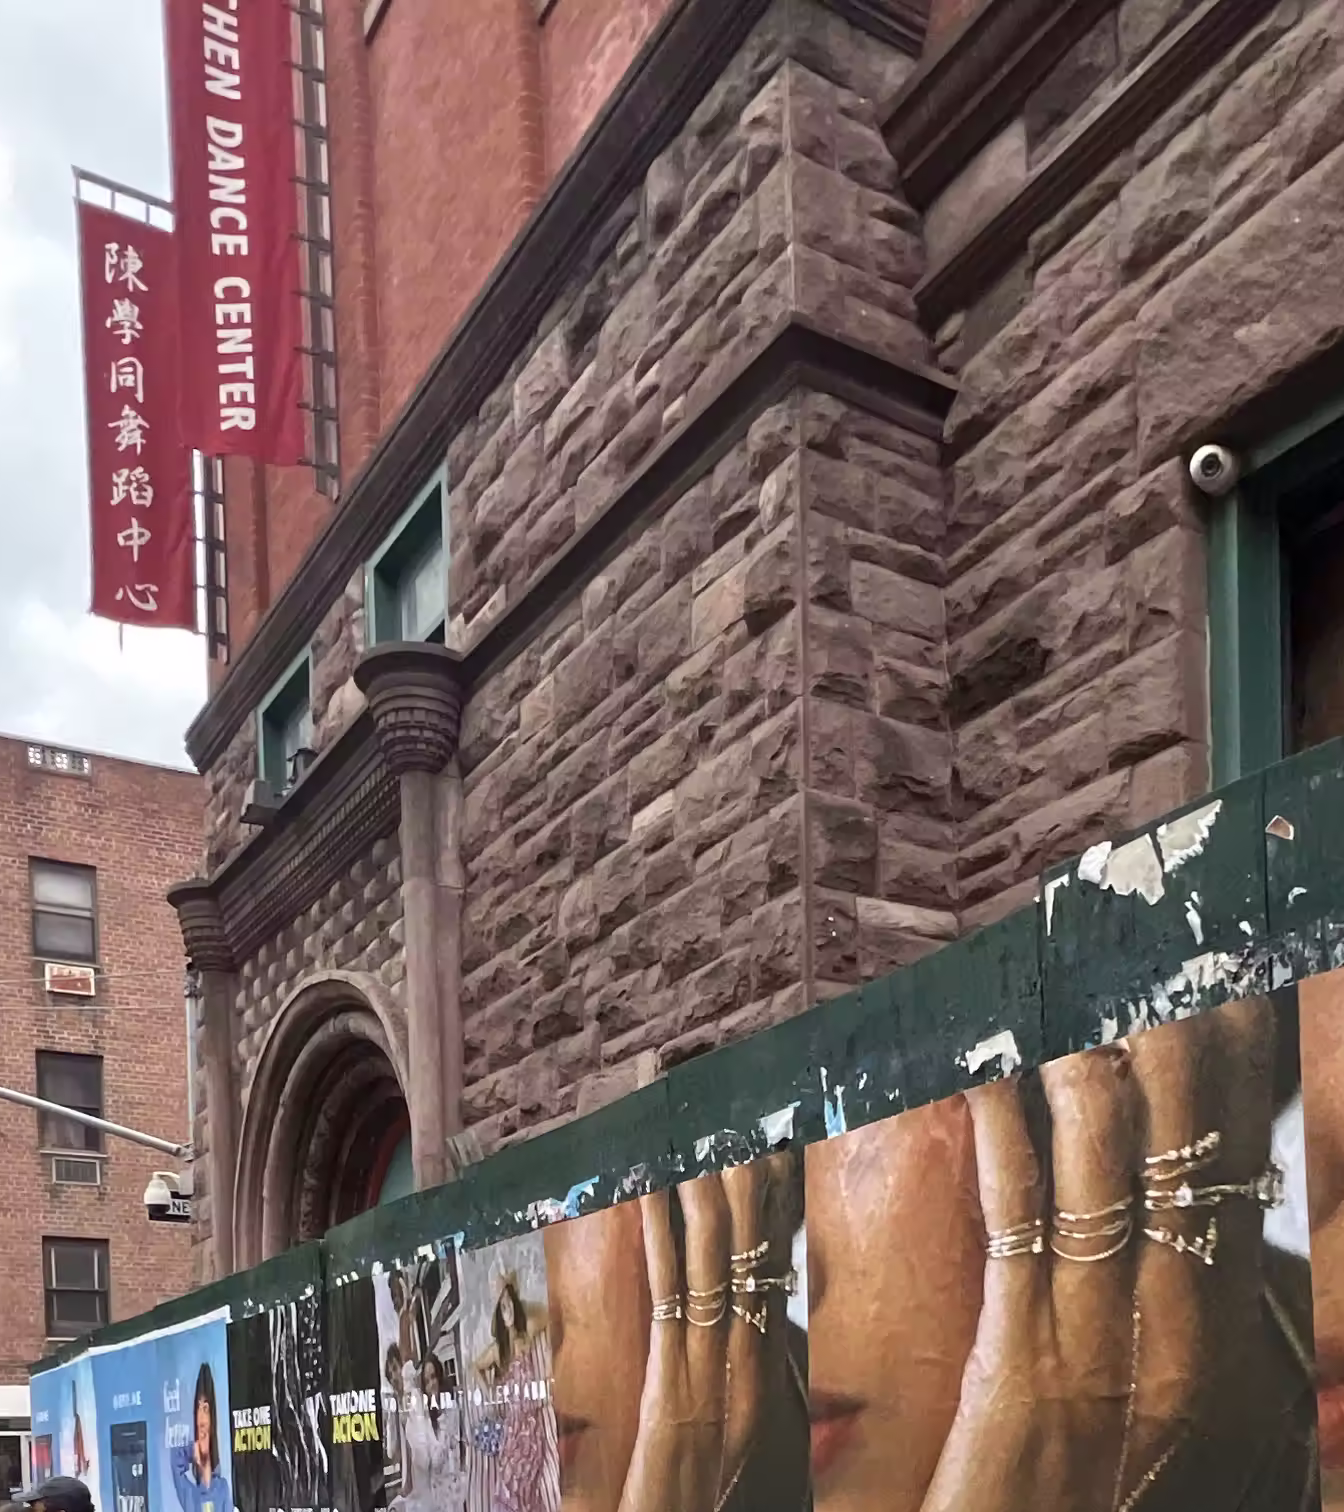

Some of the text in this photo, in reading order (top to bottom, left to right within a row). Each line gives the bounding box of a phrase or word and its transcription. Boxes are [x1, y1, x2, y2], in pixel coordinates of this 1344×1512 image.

[203, 0, 256, 431] HEN DANCE CENTER
[104, 242, 160, 611] 陳學同舞蹈中心
[171, 1201, 189, 1213] NE
[351, 1389, 376, 1413] ONE
[233, 1405, 271, 1428] TAKE ONE
[234, 1425, 272, 1453] ACTION
